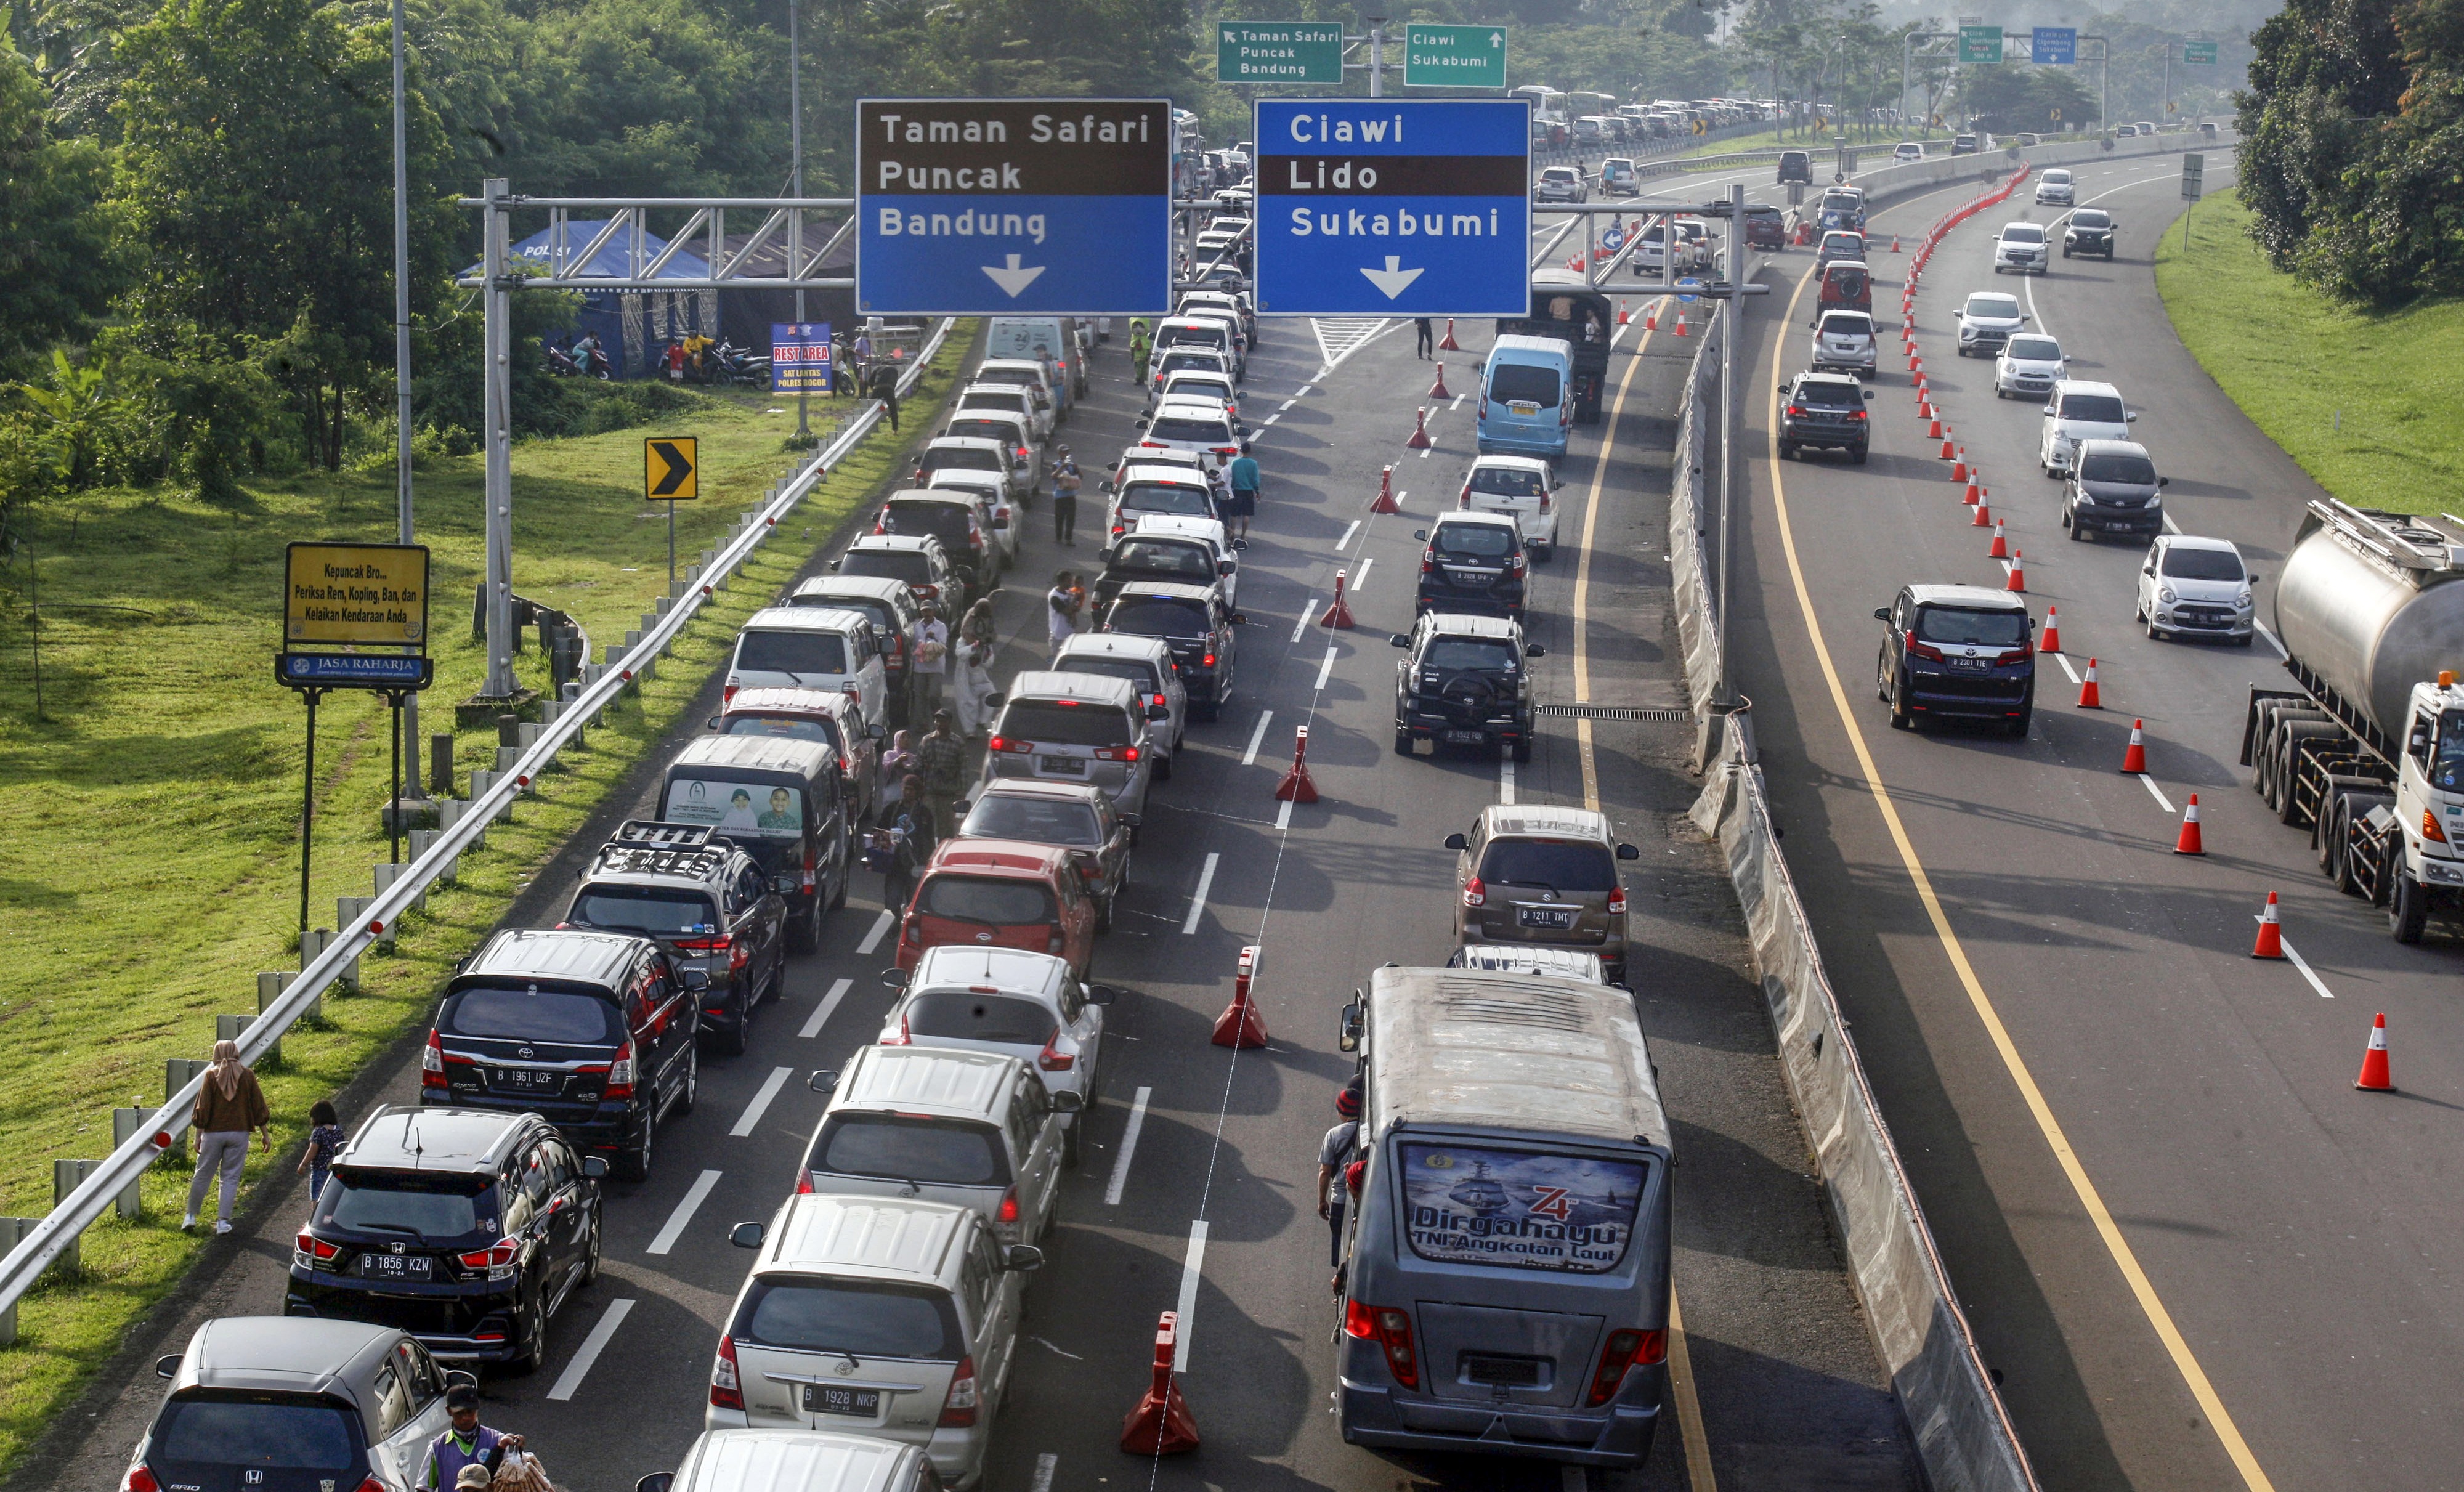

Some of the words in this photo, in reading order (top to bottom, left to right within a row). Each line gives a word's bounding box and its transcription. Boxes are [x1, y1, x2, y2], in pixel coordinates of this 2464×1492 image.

[1242, 31, 1289, 41] Taman
[1295, 31, 1339, 42] Safari
[1412, 34, 1454, 46] Ciawi
[1241, 47, 1295, 57] Puncak
[1412, 54, 1487, 67] Sukabumi
[1241, 63, 1305, 77] Bandung
[880, 115, 1007, 143] Taman
[1029, 115, 1149, 143] Safari
[1290, 114, 1403, 143] Ciawi
[880, 161, 1021, 189] Puncak
[1290, 161, 1377, 189] Lido
[880, 208, 1046, 243] Bandung
[1291, 208, 1499, 237] Sukabumi
[774, 347, 800, 362] REST
[801, 346, 829, 361] AREA
[783, 370, 795, 378] SAT
[803, 379, 827, 387] BOGOR
[325, 563, 364, 581] Kepuncak
[366, 565, 387, 580] Bro...
[295, 585, 325, 599] Periksa
[327, 586, 347, 603] Rem,
[349, 586, 380, 604] Kopling,
[382, 587, 400, 603] Ban,
[402, 588, 416, 602] dan
[306, 607, 339, 622] Kelaikan
[341, 608, 384, 623] Kendaraan
[386, 609, 407, 623] Anda
[318, 658, 349, 669] JASA
[353, 659, 413, 671] RAHARJA
[1523, 911, 1528, 920] B
[1533, 911, 1549, 920] 1211
[1554, 912, 1568, 923] TMT
[498, 1070, 504, 1080] B
[513, 1071, 531, 1082] 1961
[535, 1072, 552, 1083] UZF
[1414, 1205, 1620, 1247] Dirgahayu
[1415, 1231, 1448, 1246] TNI
[1454, 1235, 1563, 1257] Angkatan
[365, 1255, 372, 1268] B
[379, 1256, 402, 1270] 1856
[409, 1259, 429, 1271] KZW
[804, 1388, 812, 1401] B
[824, 1390, 851, 1405] 1928
[856, 1393, 877, 1408] NKP
